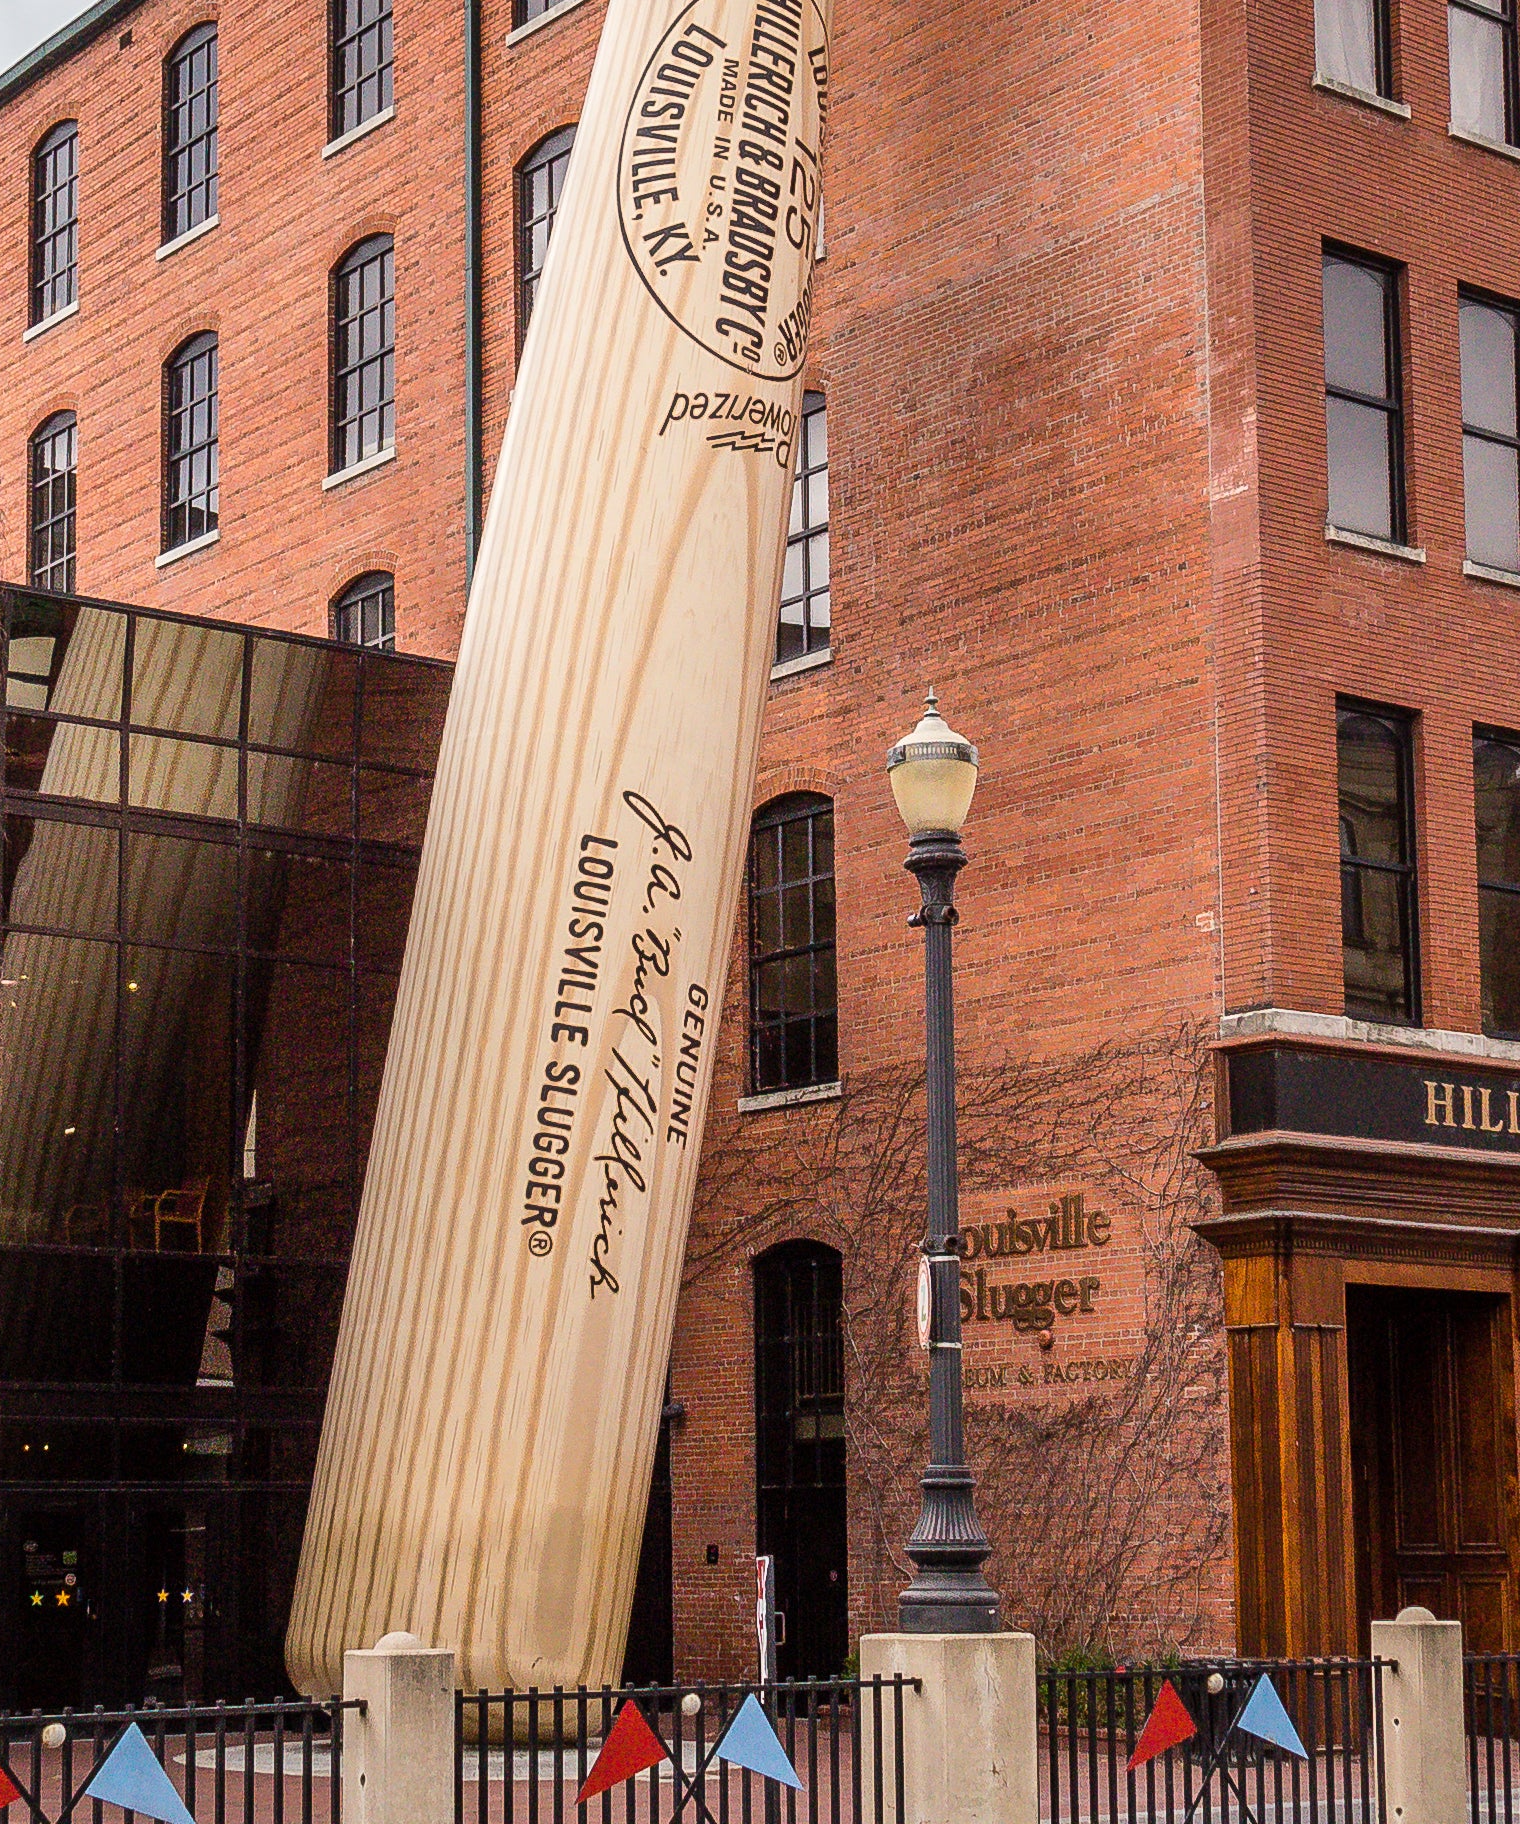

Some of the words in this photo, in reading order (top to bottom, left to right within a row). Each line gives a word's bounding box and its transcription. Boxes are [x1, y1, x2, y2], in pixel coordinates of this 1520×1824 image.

[631, 23, 728, 221] LOUISVILLE,
[717, 58, 740, 124] MADE
[713, 136, 731, 161] IN
[738, 139, 784, 172] &
[702, 174, 727, 251] U.S.A.
[786, 137, 817, 260] 125
[643, 221, 702, 277] KY.
[720, 166, 781, 328] BRADSBY
[551, 834, 618, 1047] LOUISVILLE
[666, 983, 709, 1151] GENUINE
[958, 1193, 1112, 1260] ouisville
